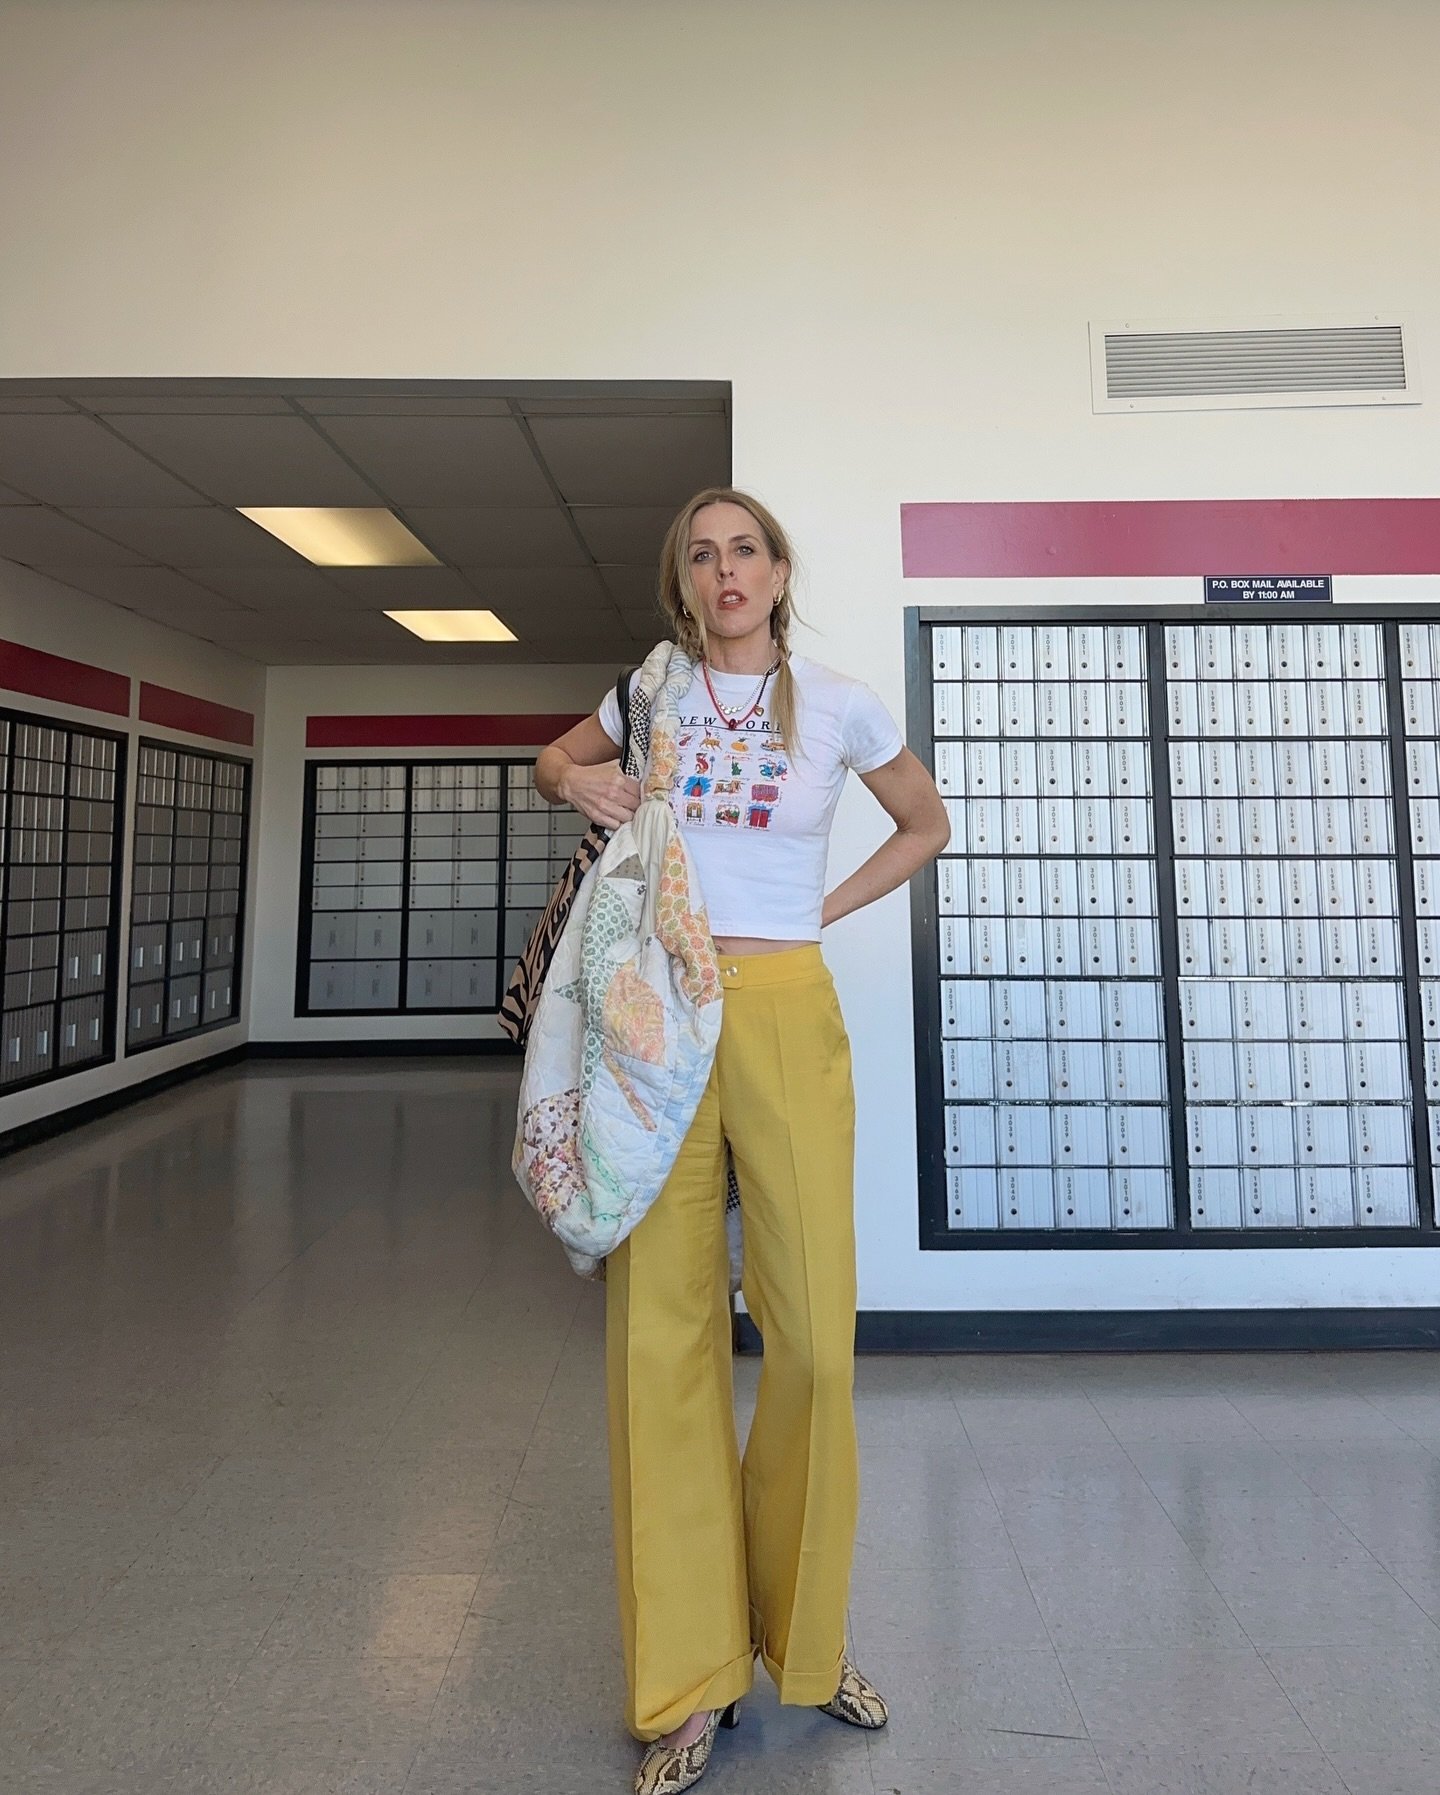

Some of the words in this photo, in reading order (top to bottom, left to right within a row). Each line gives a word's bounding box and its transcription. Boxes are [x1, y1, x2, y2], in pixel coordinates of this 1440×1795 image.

[1212, 580, 1228, 588] P.O.
[1231, 580, 1250, 588] BOX
[1252, 580, 1274, 588] MAIL
[1276, 580, 1324, 588] AVAILABLE
[1243, 591, 1255, 599] BY
[1258, 591, 1278, 599] 11:00
[1280, 591, 1295, 599] AM
